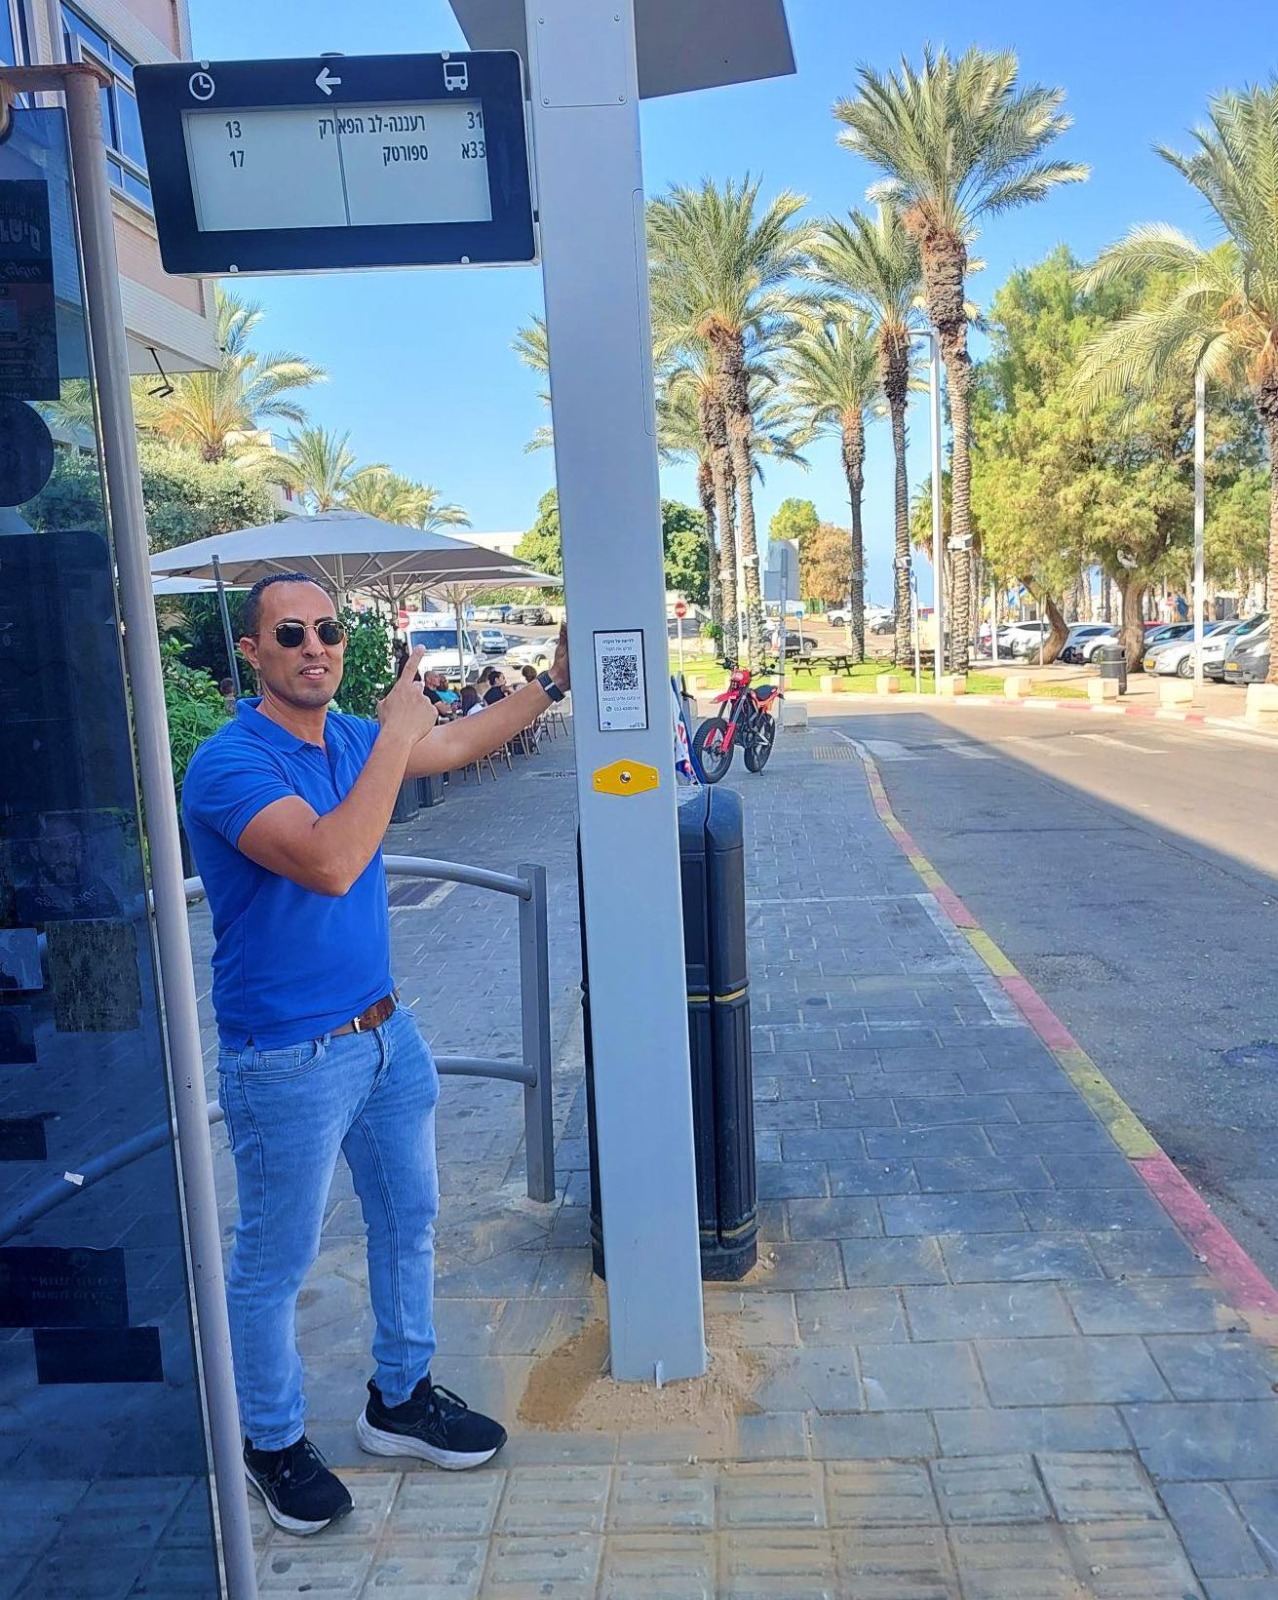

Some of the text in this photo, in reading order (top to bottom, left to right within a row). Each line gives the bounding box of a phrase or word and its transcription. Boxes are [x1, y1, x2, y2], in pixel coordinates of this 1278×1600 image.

[225, 111, 482, 140] 31 רעננה-לב הפארק 13
[229, 150, 245, 168] 17
[382, 145, 428, 167] ספורטק
